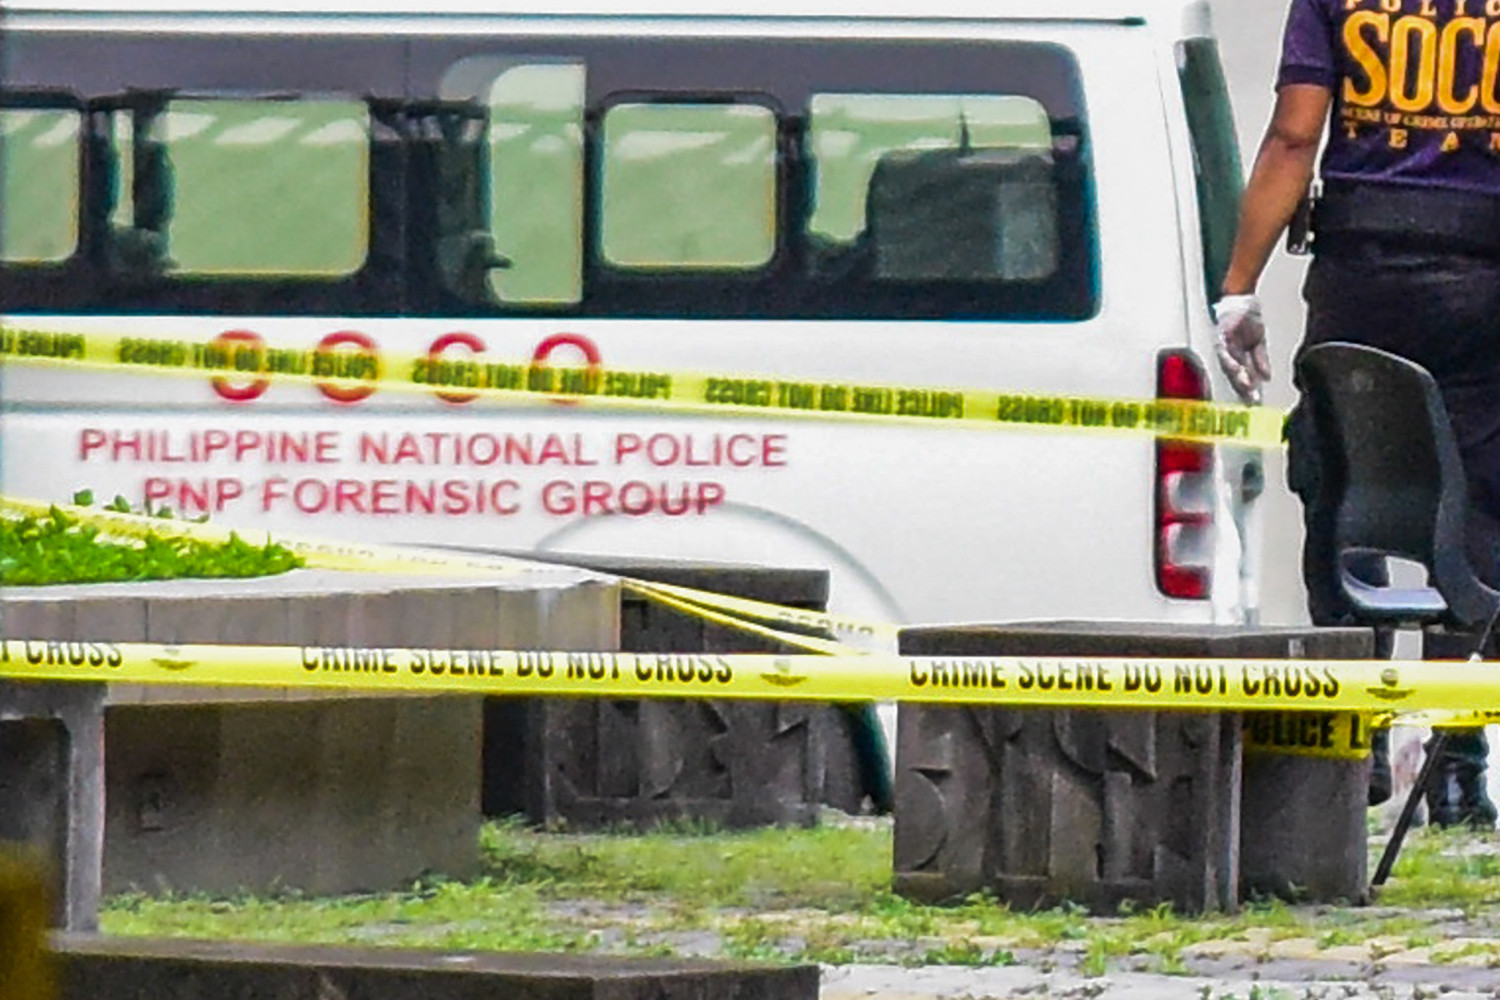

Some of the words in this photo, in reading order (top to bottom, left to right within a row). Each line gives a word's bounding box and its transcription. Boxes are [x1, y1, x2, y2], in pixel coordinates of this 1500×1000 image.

[80, 428, 341, 463] PHILIPPINE
[361, 431, 597, 467] NATIONAL
[614, 432, 788, 468] POLICE
[143, 477, 242, 513] PNP
[261, 477, 520, 517] FORENSIC
[542, 479, 725, 517] GROUP
[909, 660, 1007, 688] CRIME
[1018, 662, 1113, 691] SCENE
[1174, 665, 1228, 695] NOT
[1242, 666, 1340, 698] CROSS
